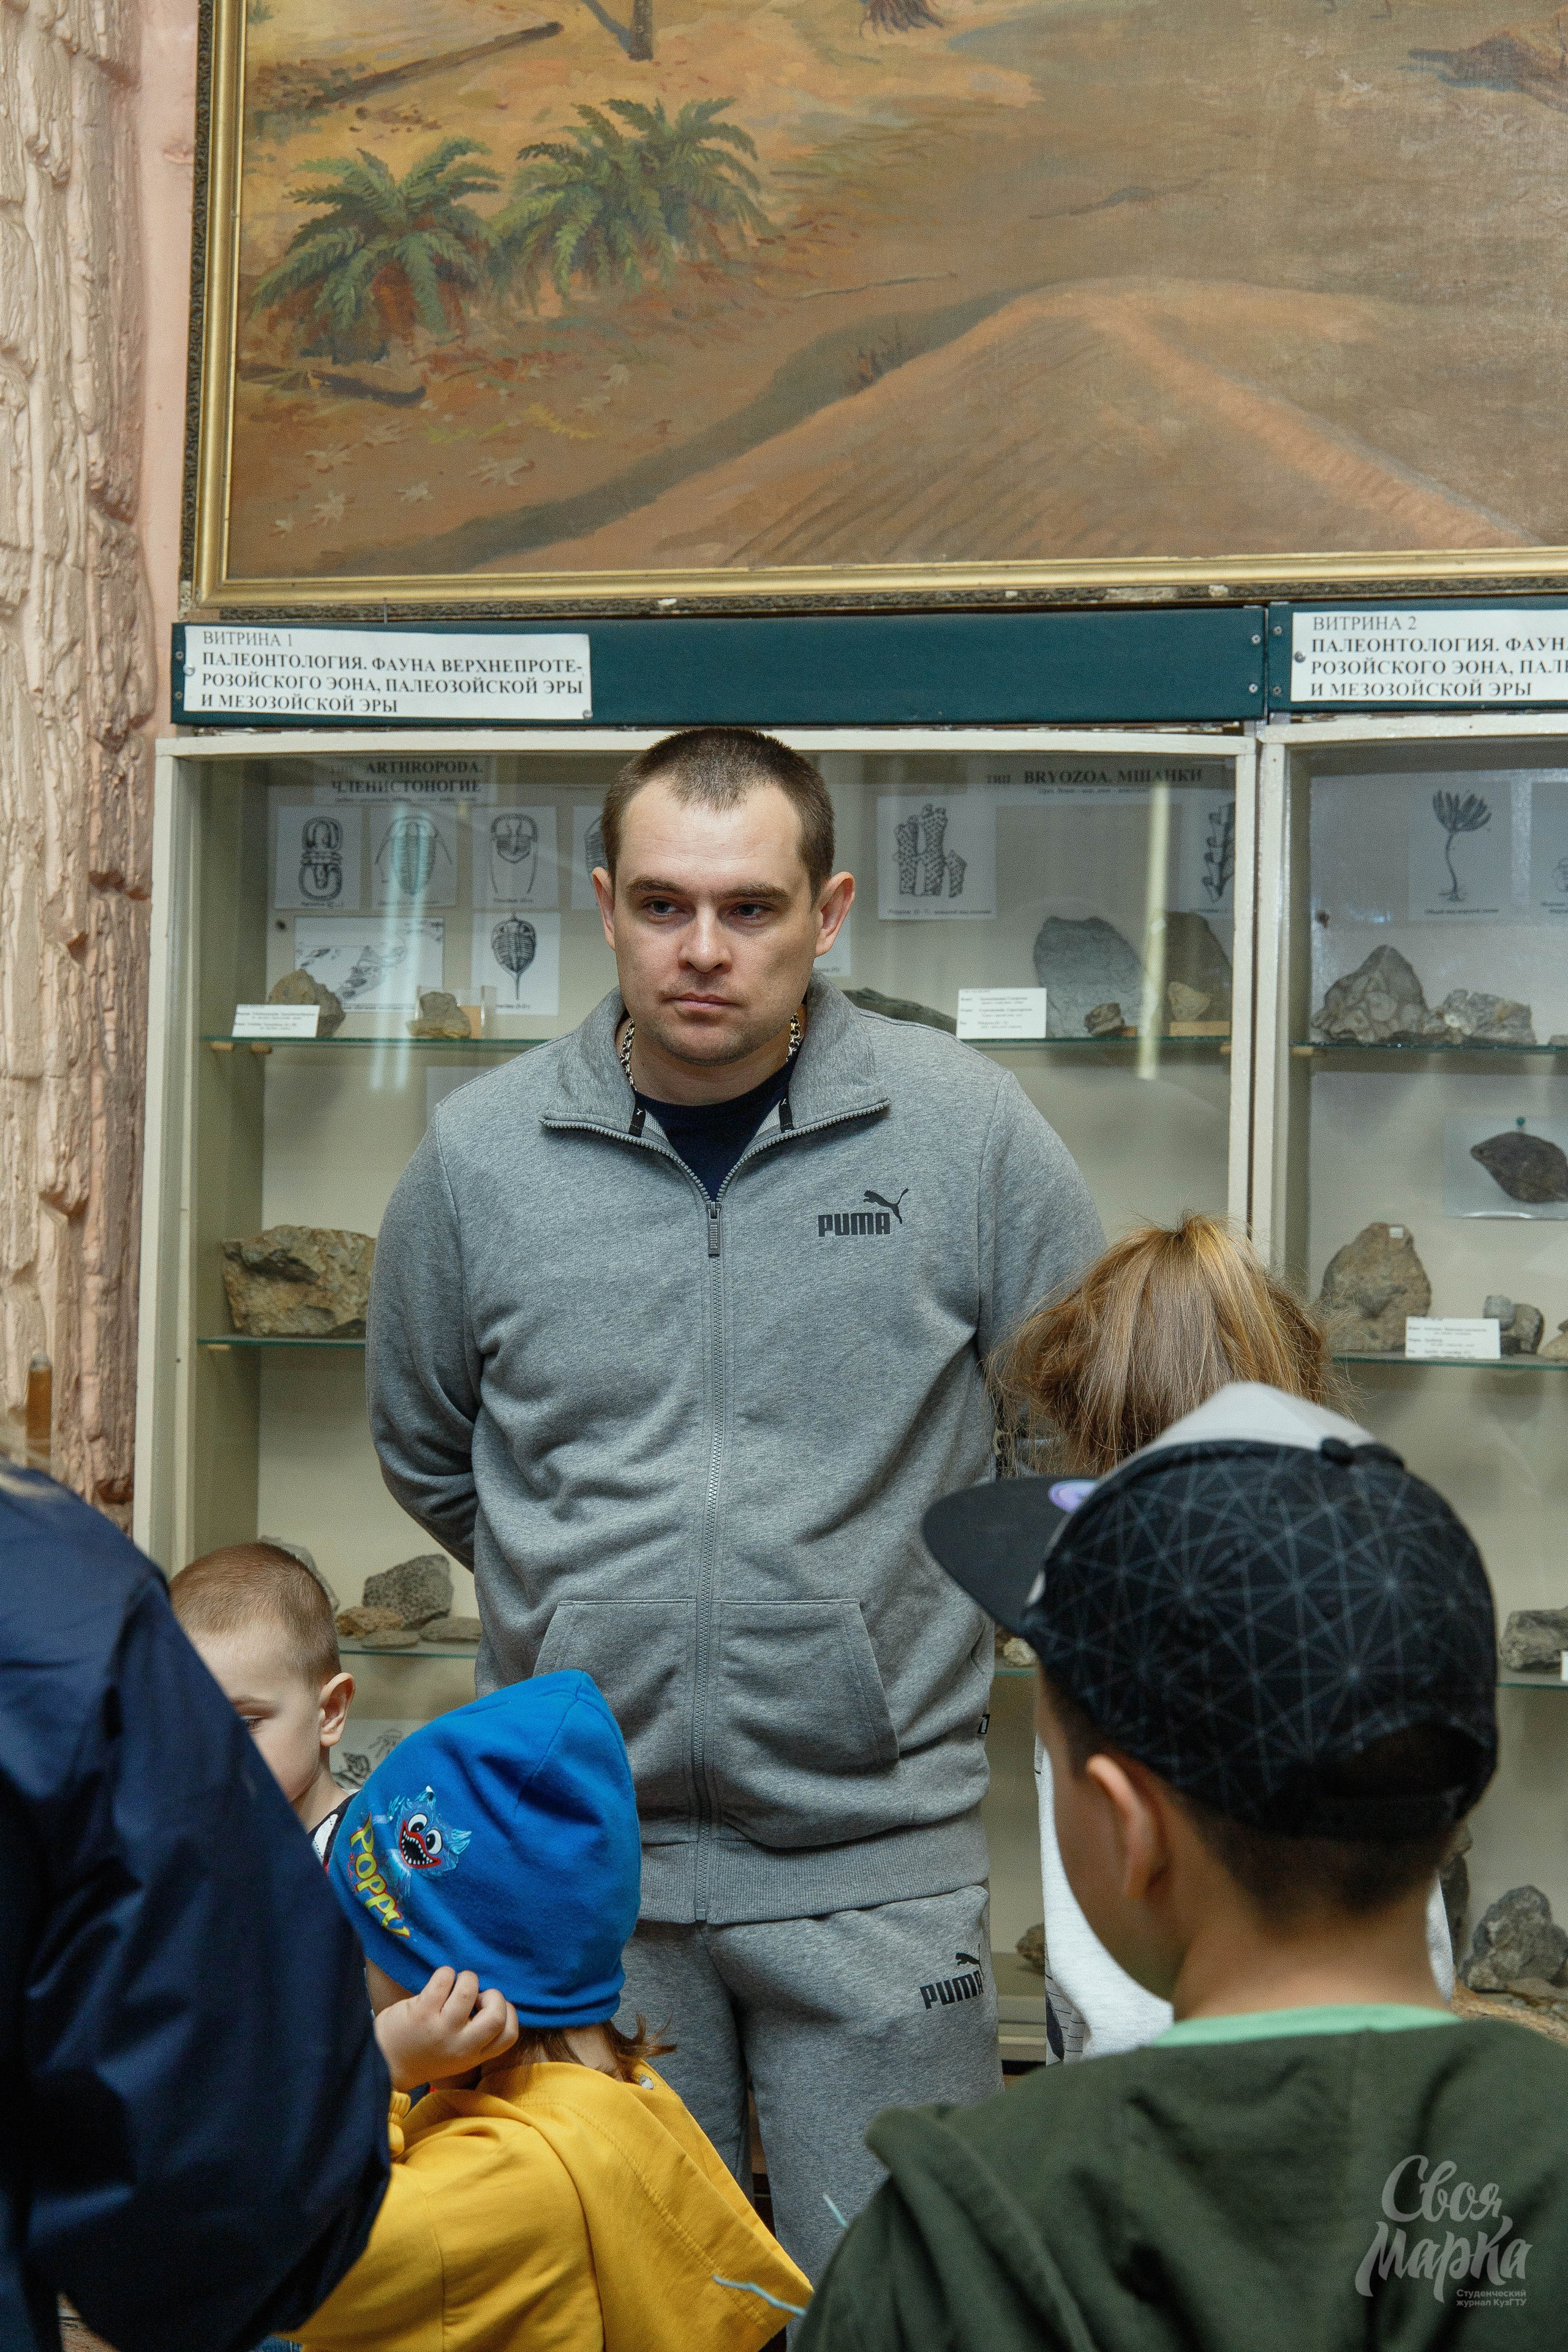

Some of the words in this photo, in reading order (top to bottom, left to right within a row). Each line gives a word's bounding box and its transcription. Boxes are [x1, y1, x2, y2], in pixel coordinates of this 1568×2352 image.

[1313, 616, 1402, 631] ВИТРИНА
[1408, 616, 1417, 630] 2
[203, 630, 281, 646] ВИТРИНА
[287, 633, 293, 646] 1
[1311, 638, 1499, 653] ПАЛЕОНТОЛОГИЯ.
[1506, 636, 1568, 651] ФАУН
[203, 651, 367, 671] ПАЛЕОНТОЛОГИЯ.
[372, 657, 435, 673] ФАУНА
[442, 658, 582, 673] ВЕРХНЕПРОТЕ-
[1311, 657, 1446, 675] РОЗОЙСКОГО
[1451, 660, 1513, 676] ЭОНА,
[202, 671, 322, 689] РОЗОЙСКОГО
[326, 677, 380, 692] ЭОНА,
[385, 676, 538, 694] ПАЛЕОЗОЙСКОЙ
[543, 679, 583, 694] ЭРЫ
[1311, 682, 1323, 696] И
[1330, 679, 1482, 696] МЕЗОЗОЙСКОЙ
[1488, 682, 1531, 696] ЭРЫ
[202, 693, 213, 707] И
[218, 693, 354, 712] МЕЗОЗОЙСКОЙ
[359, 698, 398, 713] ЭРЫ
[818, 1212, 891, 1237] PUMA
[919, 1970, 984, 2010] PUMA
